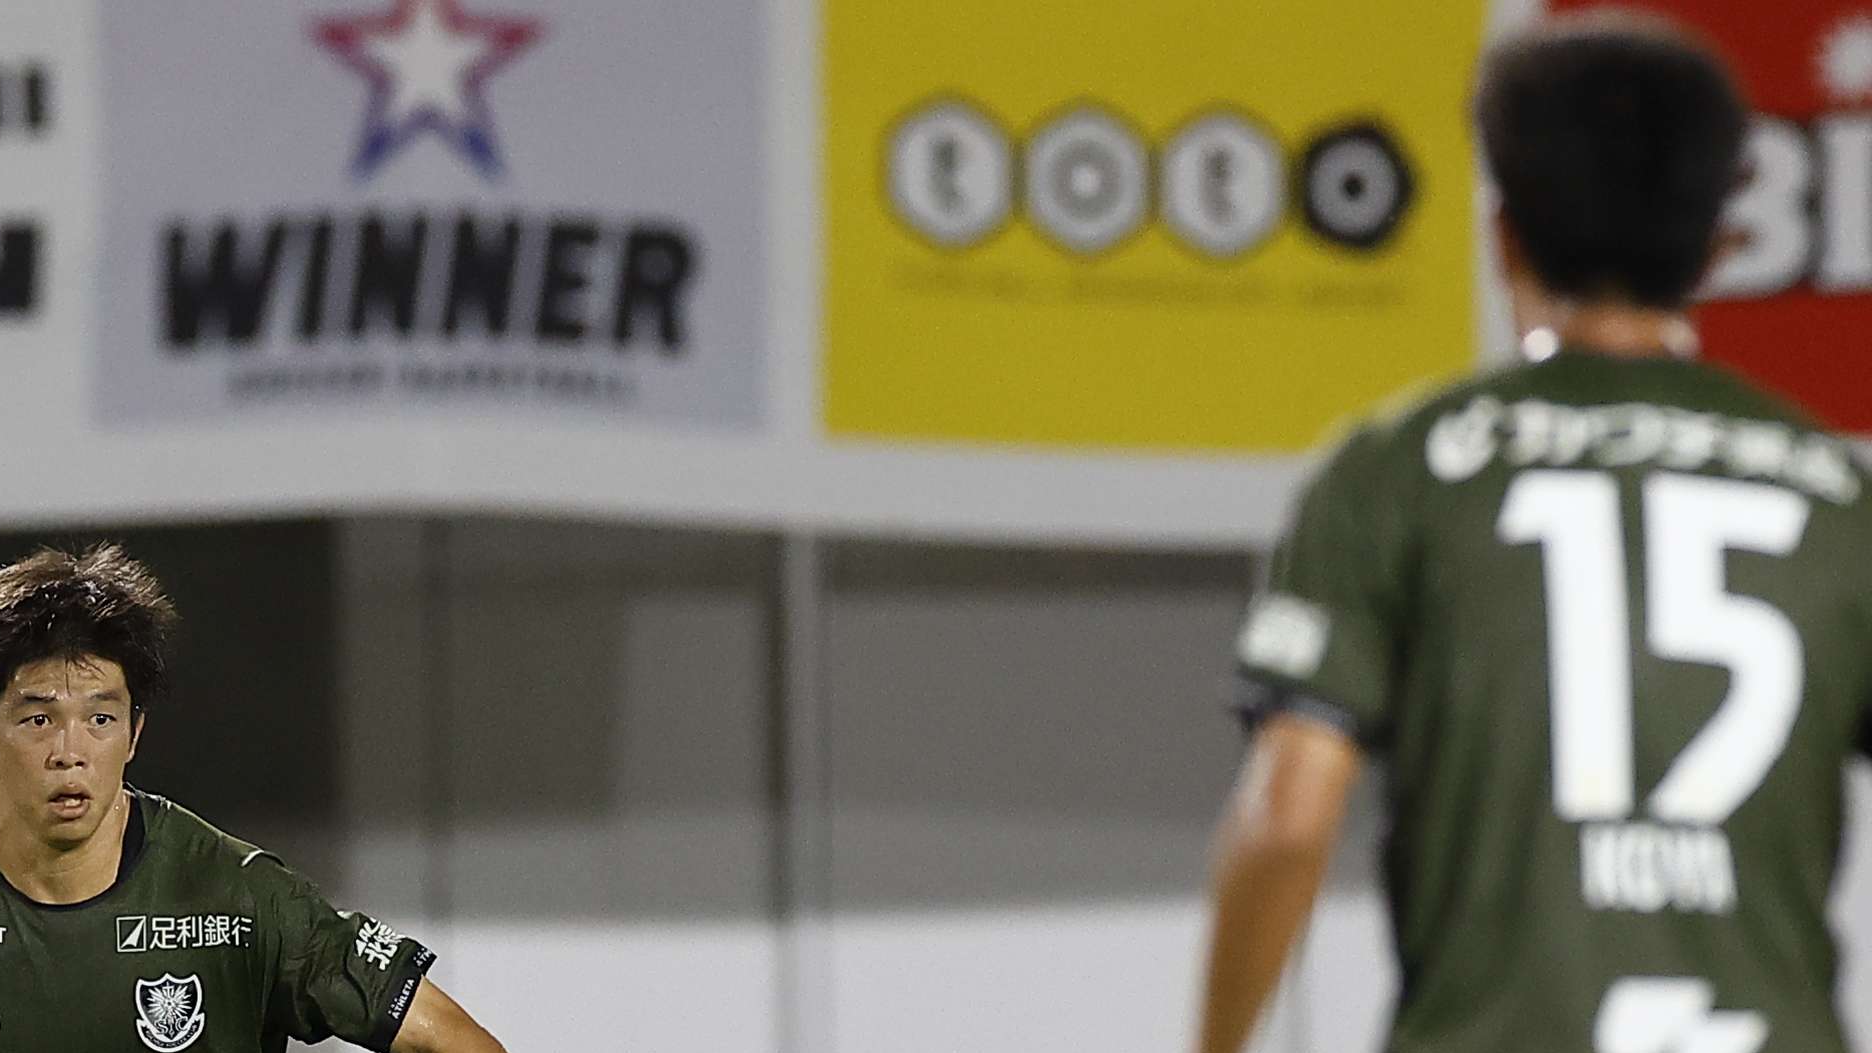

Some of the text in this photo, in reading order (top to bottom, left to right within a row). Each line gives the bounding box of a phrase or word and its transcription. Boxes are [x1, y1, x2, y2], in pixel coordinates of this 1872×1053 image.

[903, 108, 1410, 248] toto
[158, 208, 702, 358] WINNER
[1494, 468, 1812, 828] 15
[149, 914, 254, 950] 足利銀行
